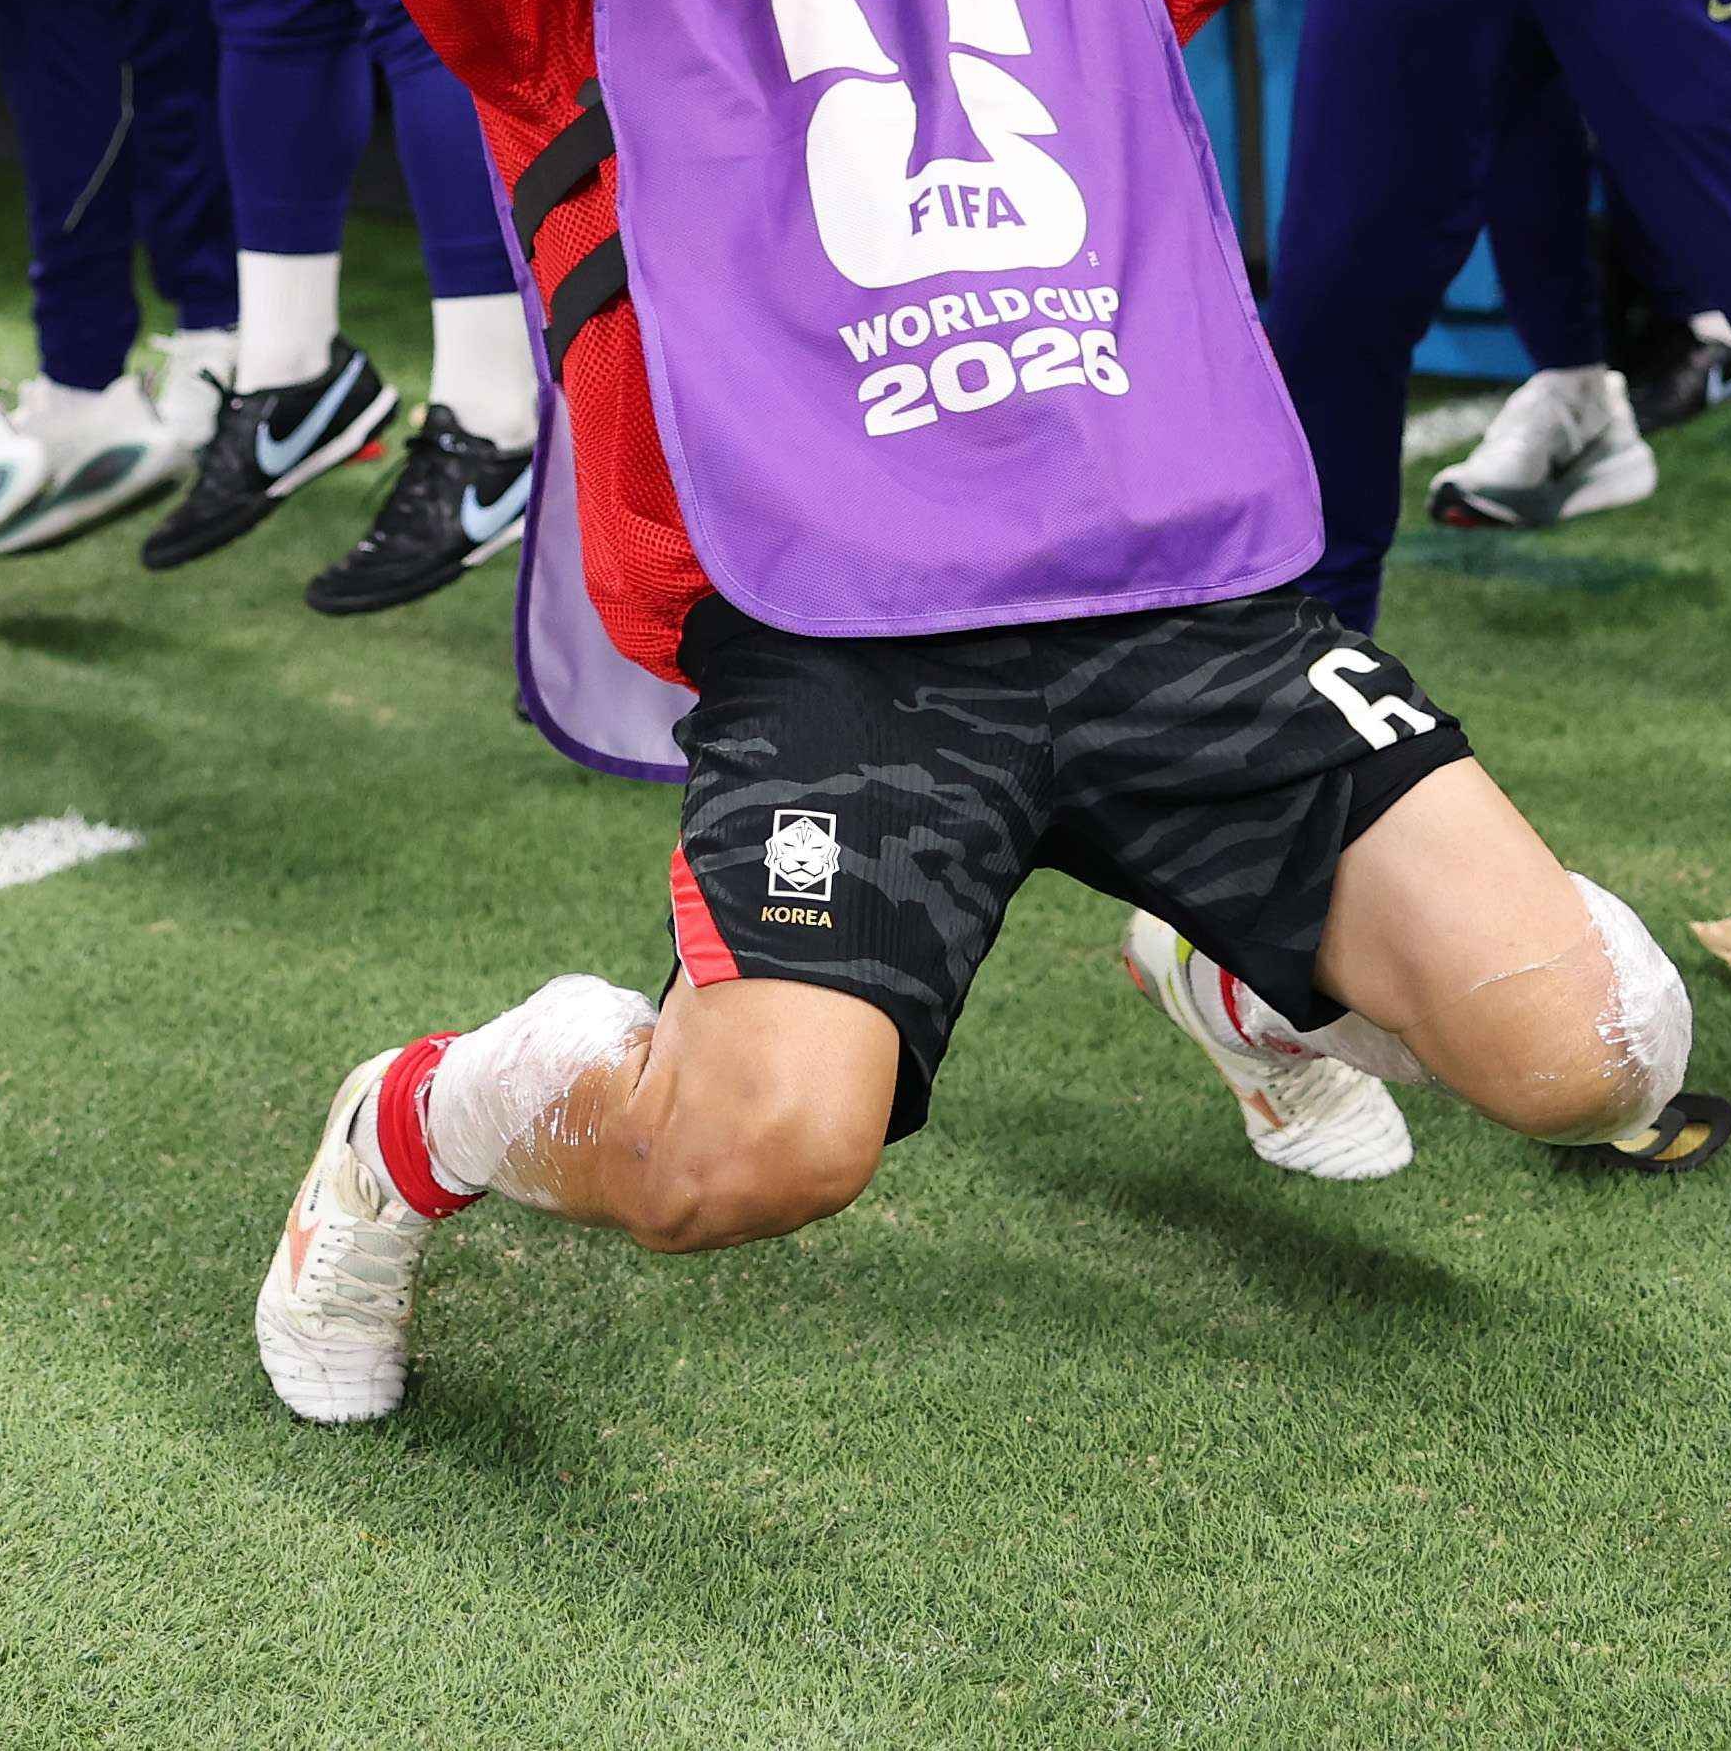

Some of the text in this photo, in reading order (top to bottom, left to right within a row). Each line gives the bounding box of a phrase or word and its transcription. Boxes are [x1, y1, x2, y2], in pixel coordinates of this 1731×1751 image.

[908, 184, 1027, 237] FIFA
[837, 285, 1120, 363] WORLD CUP
[857, 325, 1131, 437] 2026
[760, 905, 833, 929] KOREA
